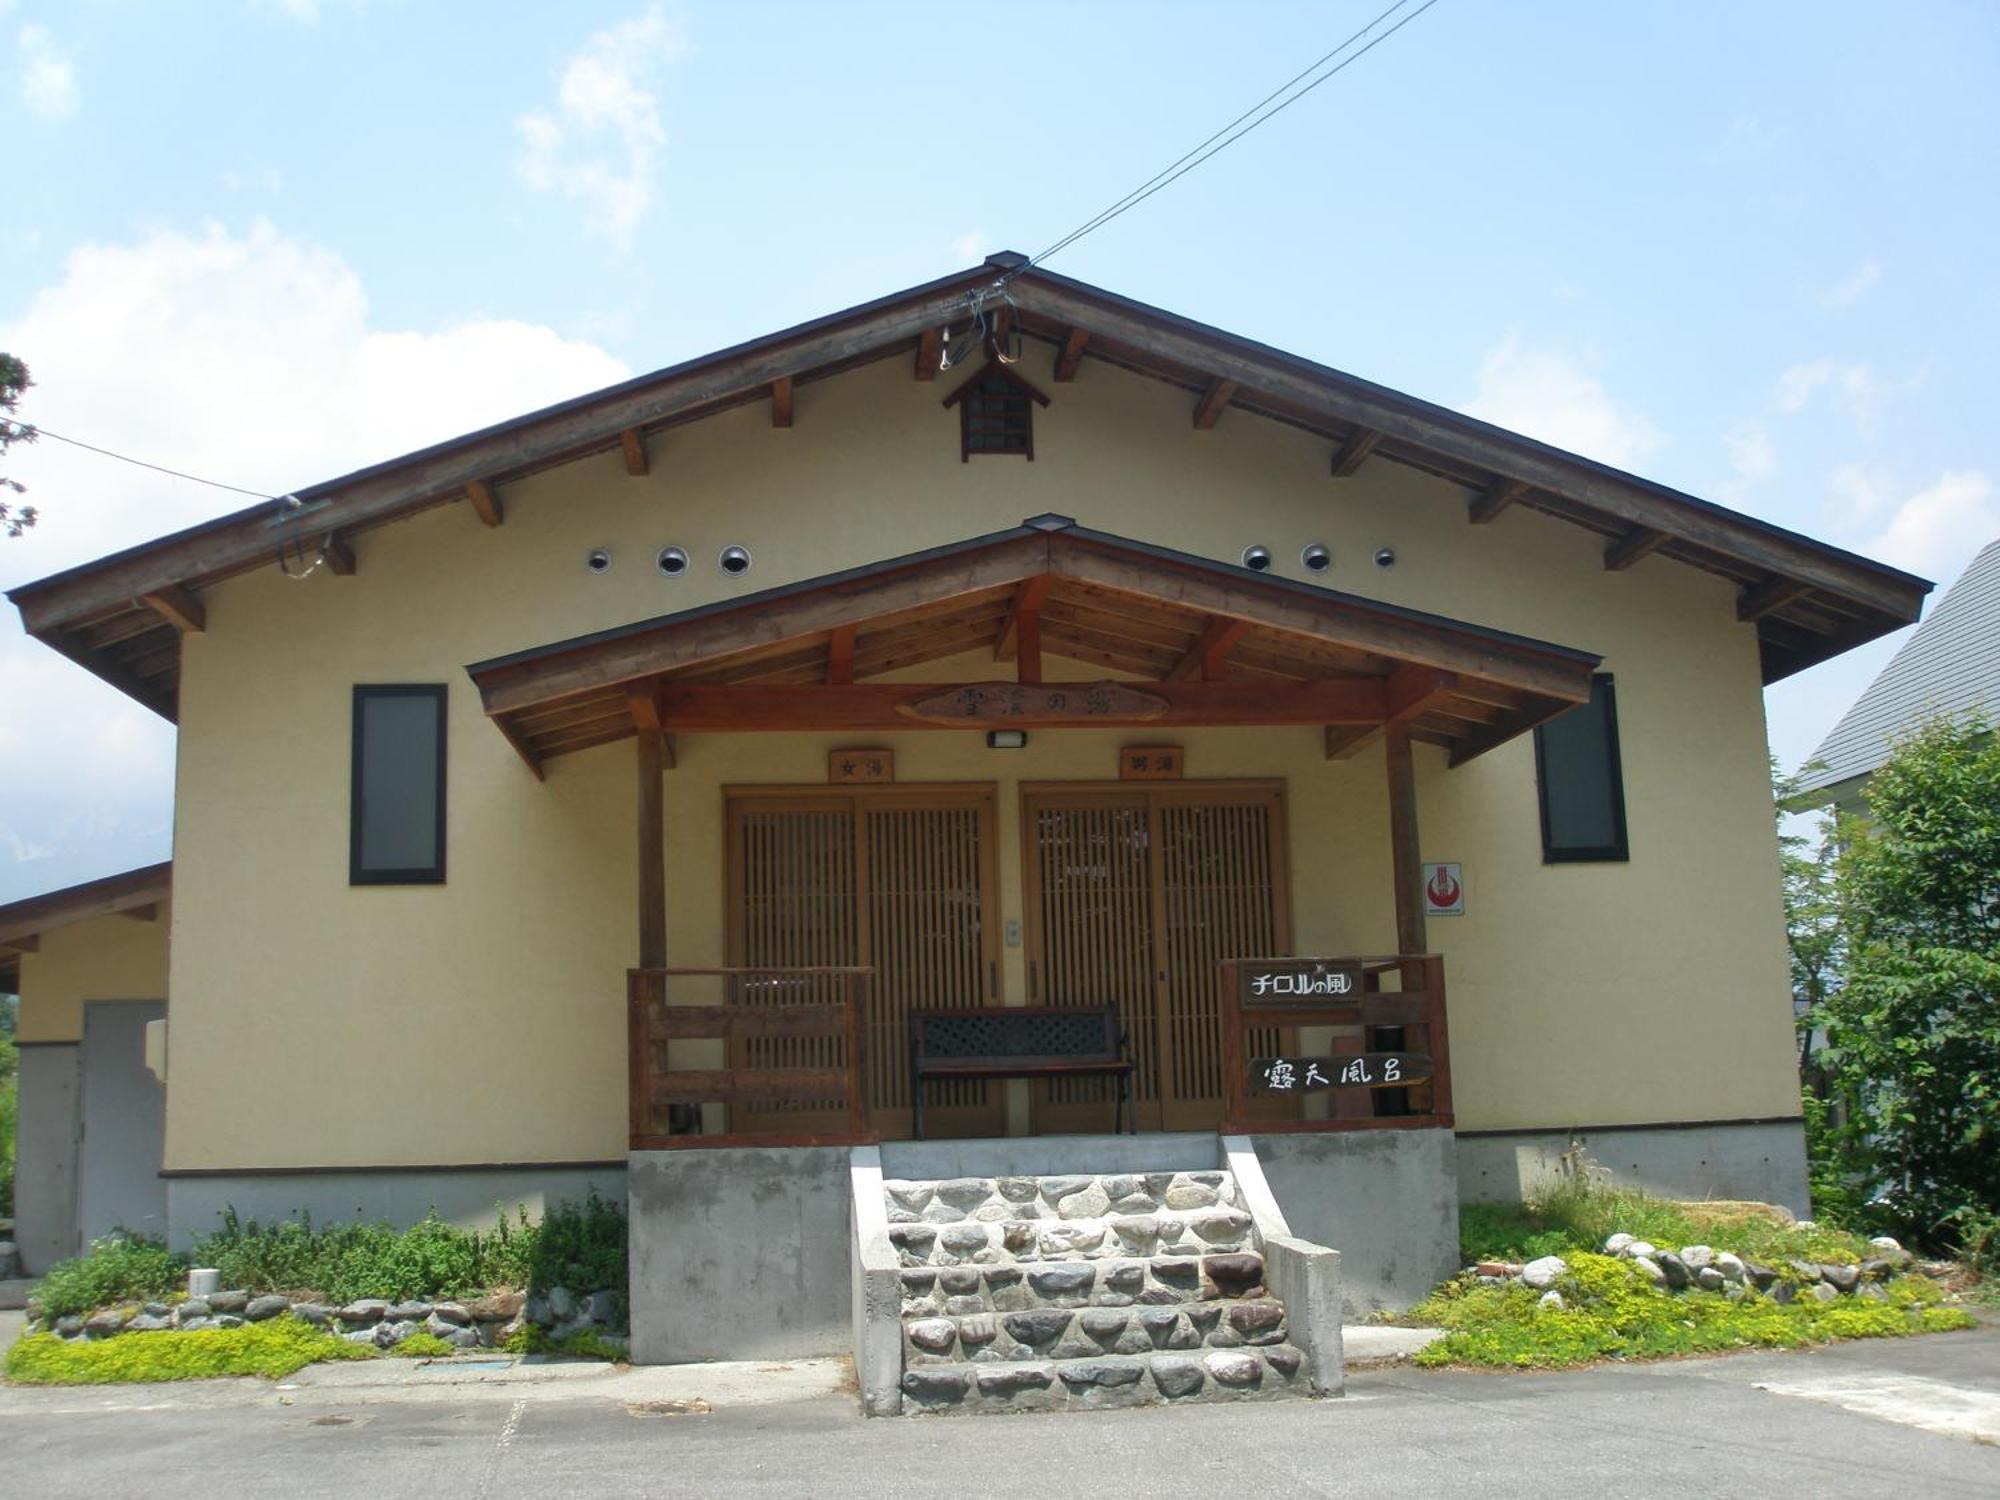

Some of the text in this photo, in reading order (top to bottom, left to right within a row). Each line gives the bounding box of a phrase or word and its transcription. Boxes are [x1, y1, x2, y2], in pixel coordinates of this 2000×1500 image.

[839, 759, 884, 777] 女湯
[1130, 755, 1173, 772] 男湯
[1252, 974, 1352, 995] チロルの風
[1264, 1058, 1401, 1089] 露天風呂
